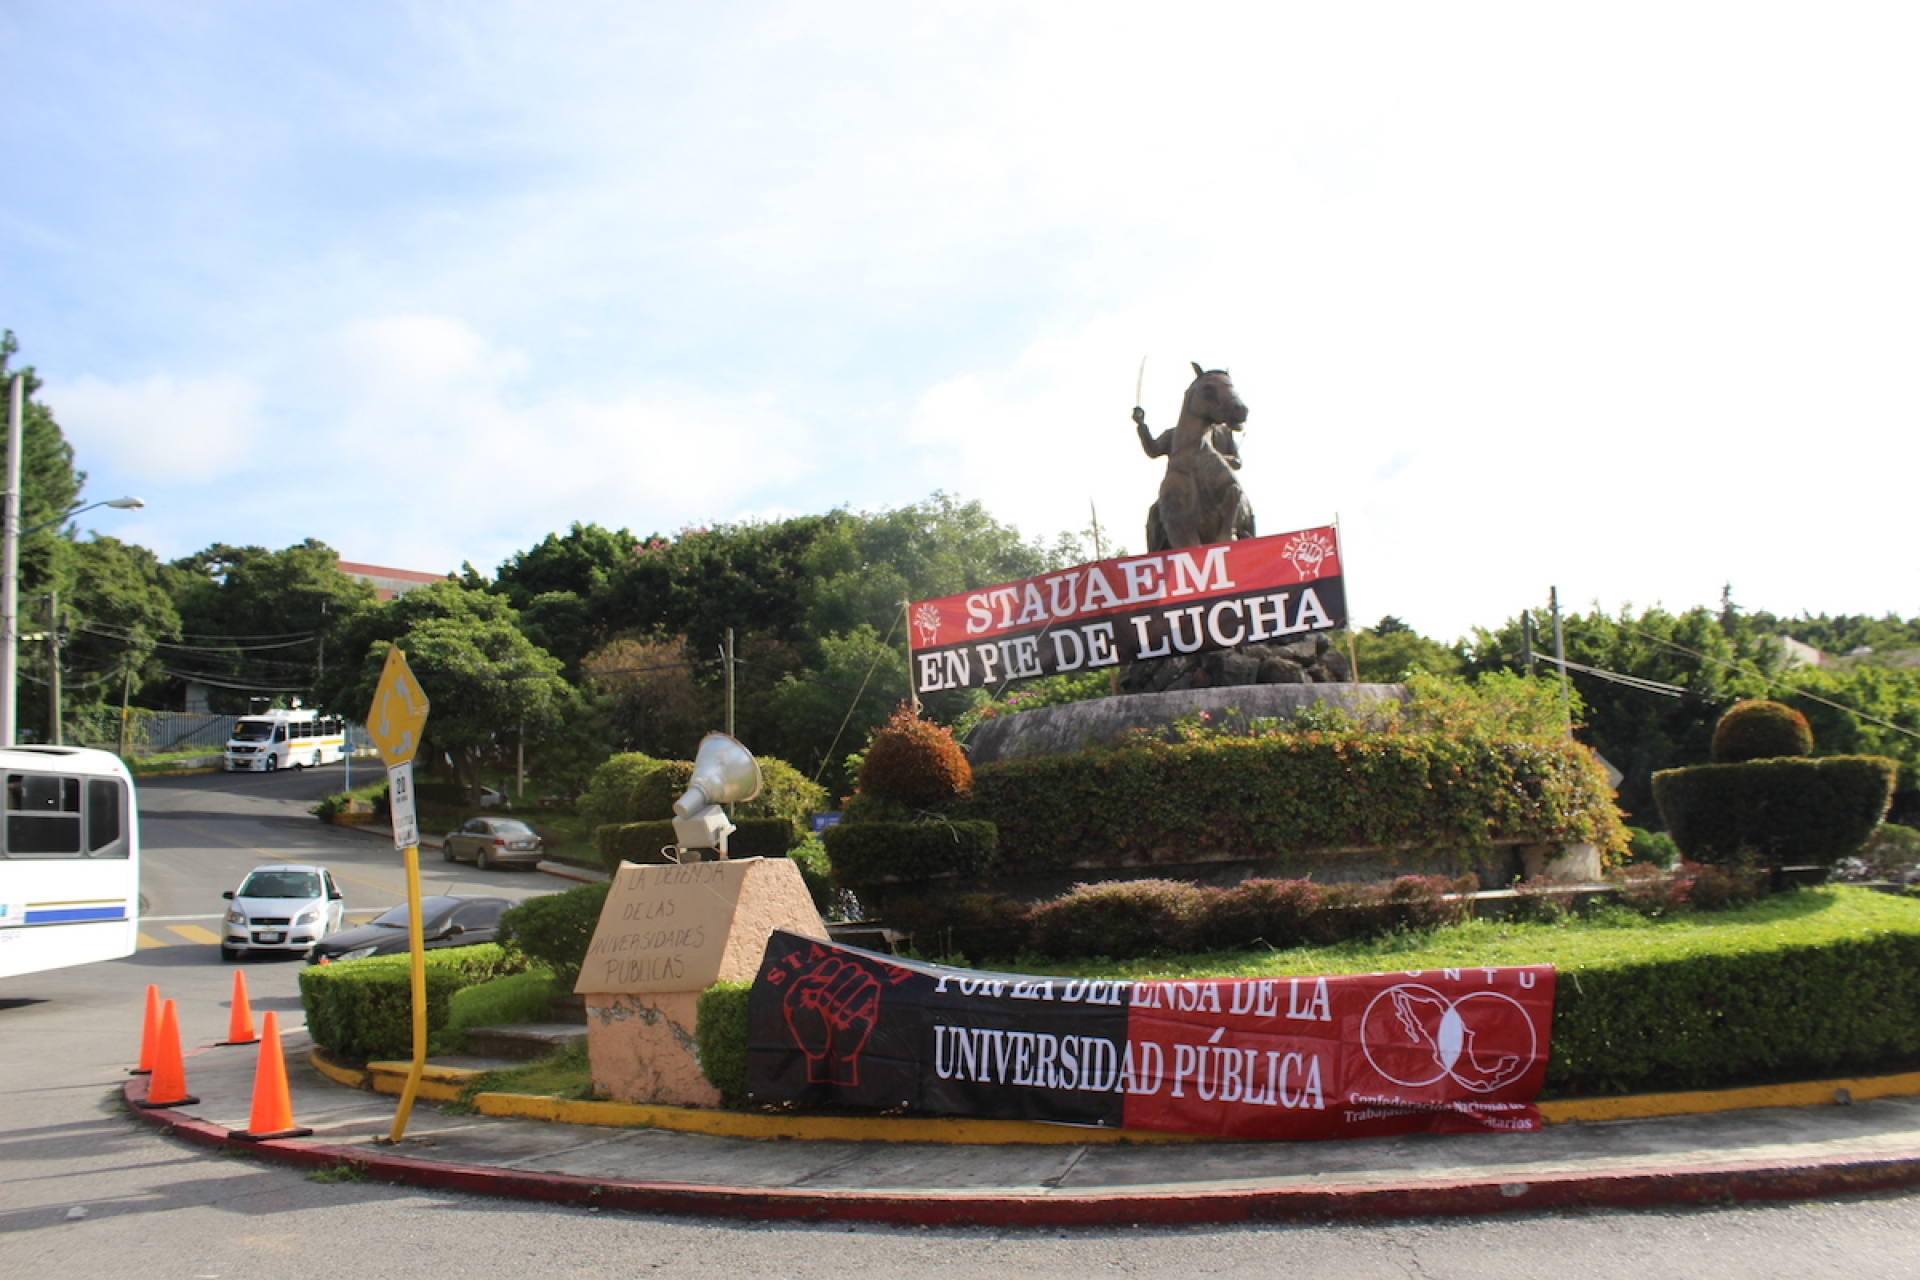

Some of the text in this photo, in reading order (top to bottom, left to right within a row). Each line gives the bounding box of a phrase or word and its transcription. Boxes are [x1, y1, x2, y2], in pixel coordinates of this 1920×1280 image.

[965, 546, 1235, 634] STAUAEM
[918, 587, 1334, 693] EN PIE DE LUCHA
[622, 899, 675, 920] DE LAS
[627, 869, 646, 891] LA
[1229, 979, 1279, 1017] DE
[1286, 977, 1332, 1021] LA
[933, 1025, 1326, 1110] UNIVERSIDAD PÚBLICA
